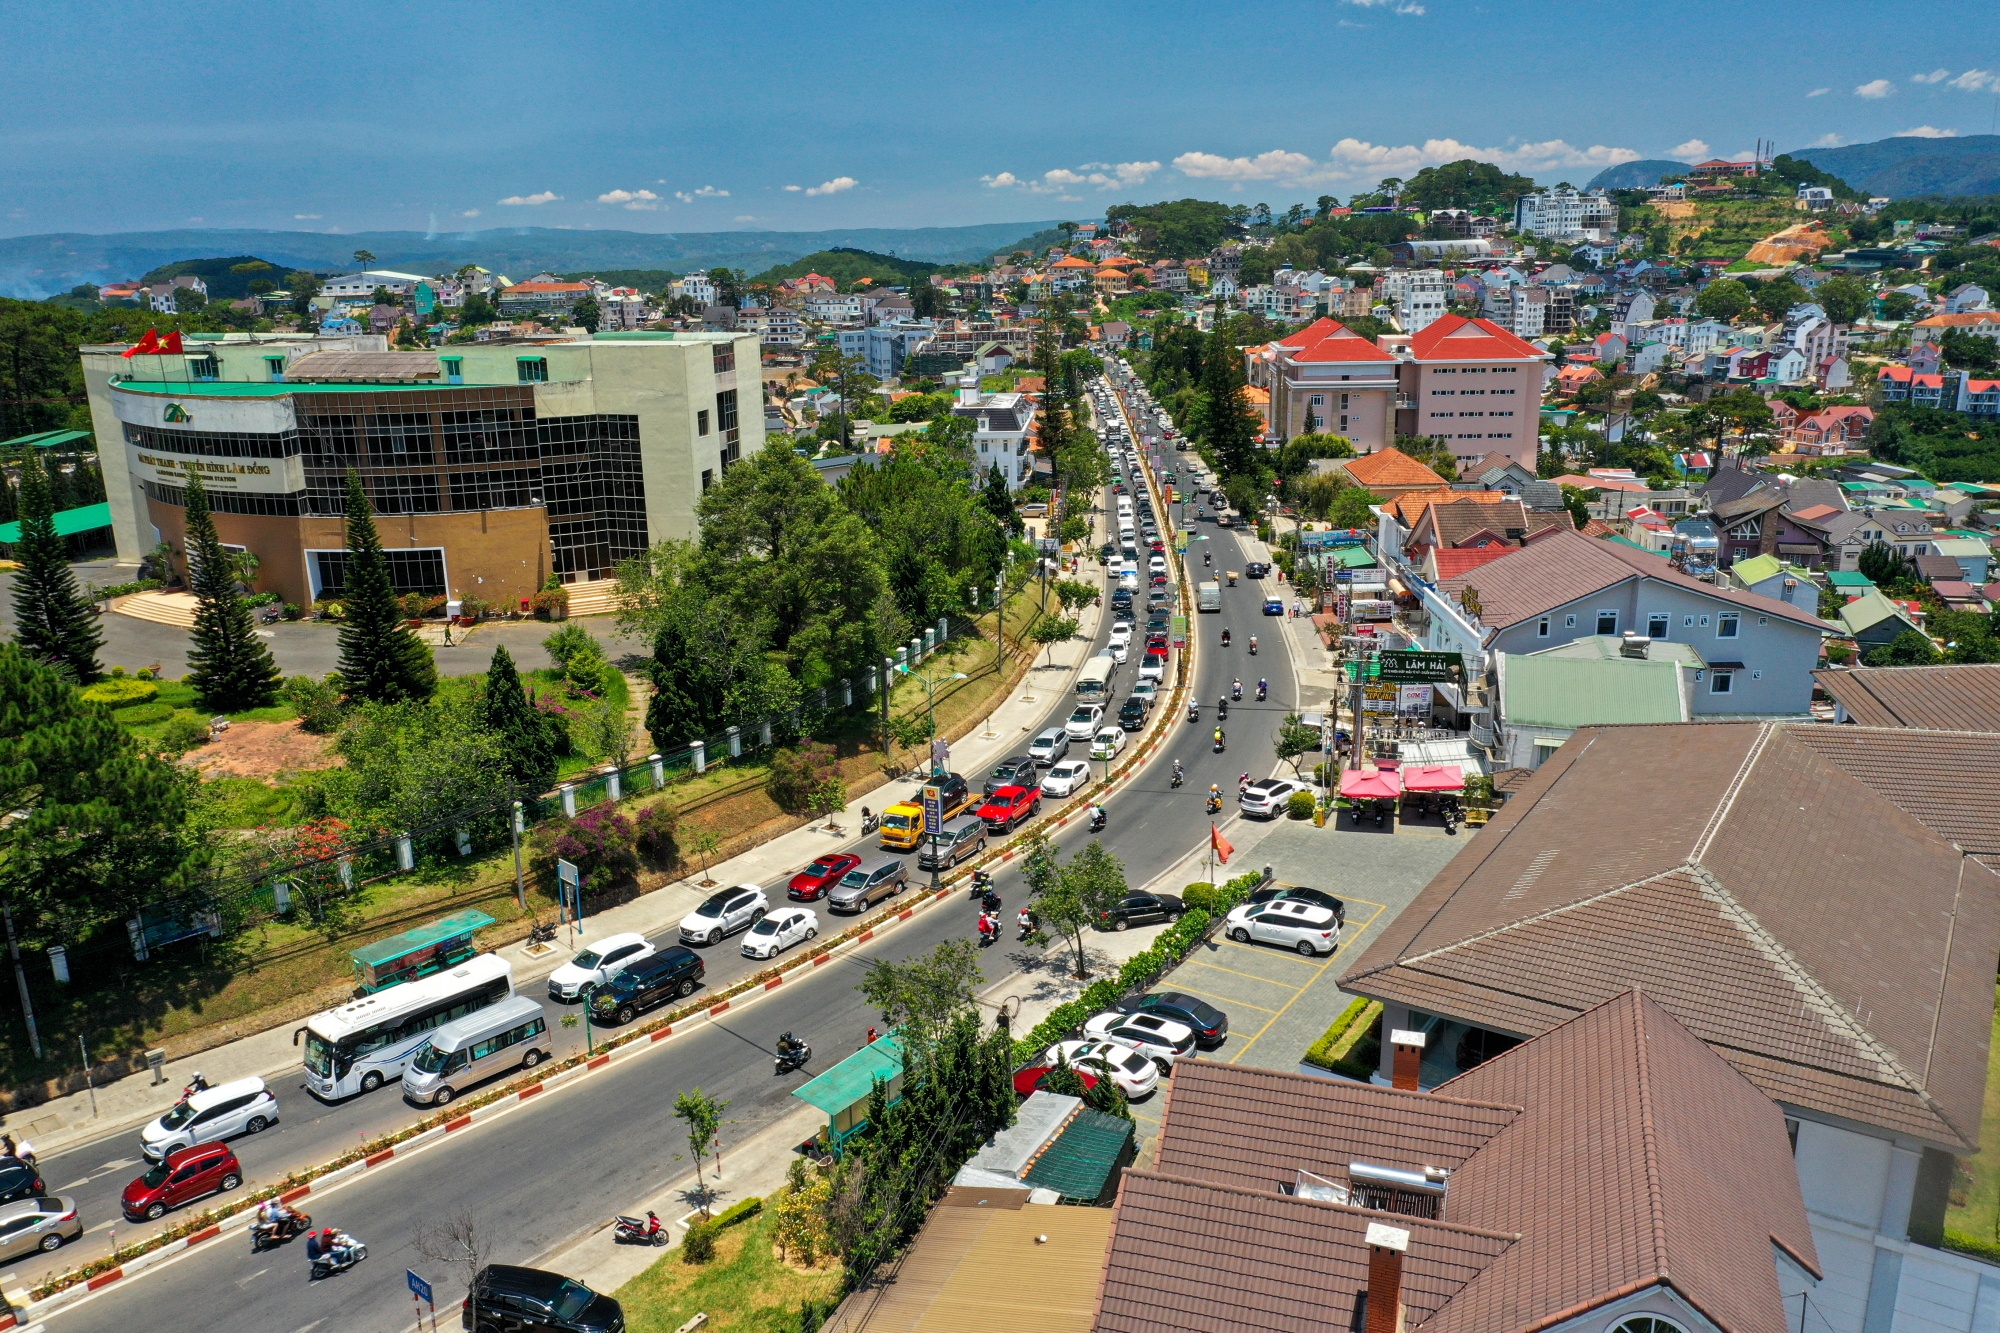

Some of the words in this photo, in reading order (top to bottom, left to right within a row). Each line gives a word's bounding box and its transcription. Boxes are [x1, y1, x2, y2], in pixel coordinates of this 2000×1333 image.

[206, 461, 225, 474] HÌNH
[226, 462, 245, 475] LÂM
[247, 460, 271, 475] ĐỒNG
[1405, 659, 1426, 670] LÂM
[1429, 659, 1446, 670] HẢI
